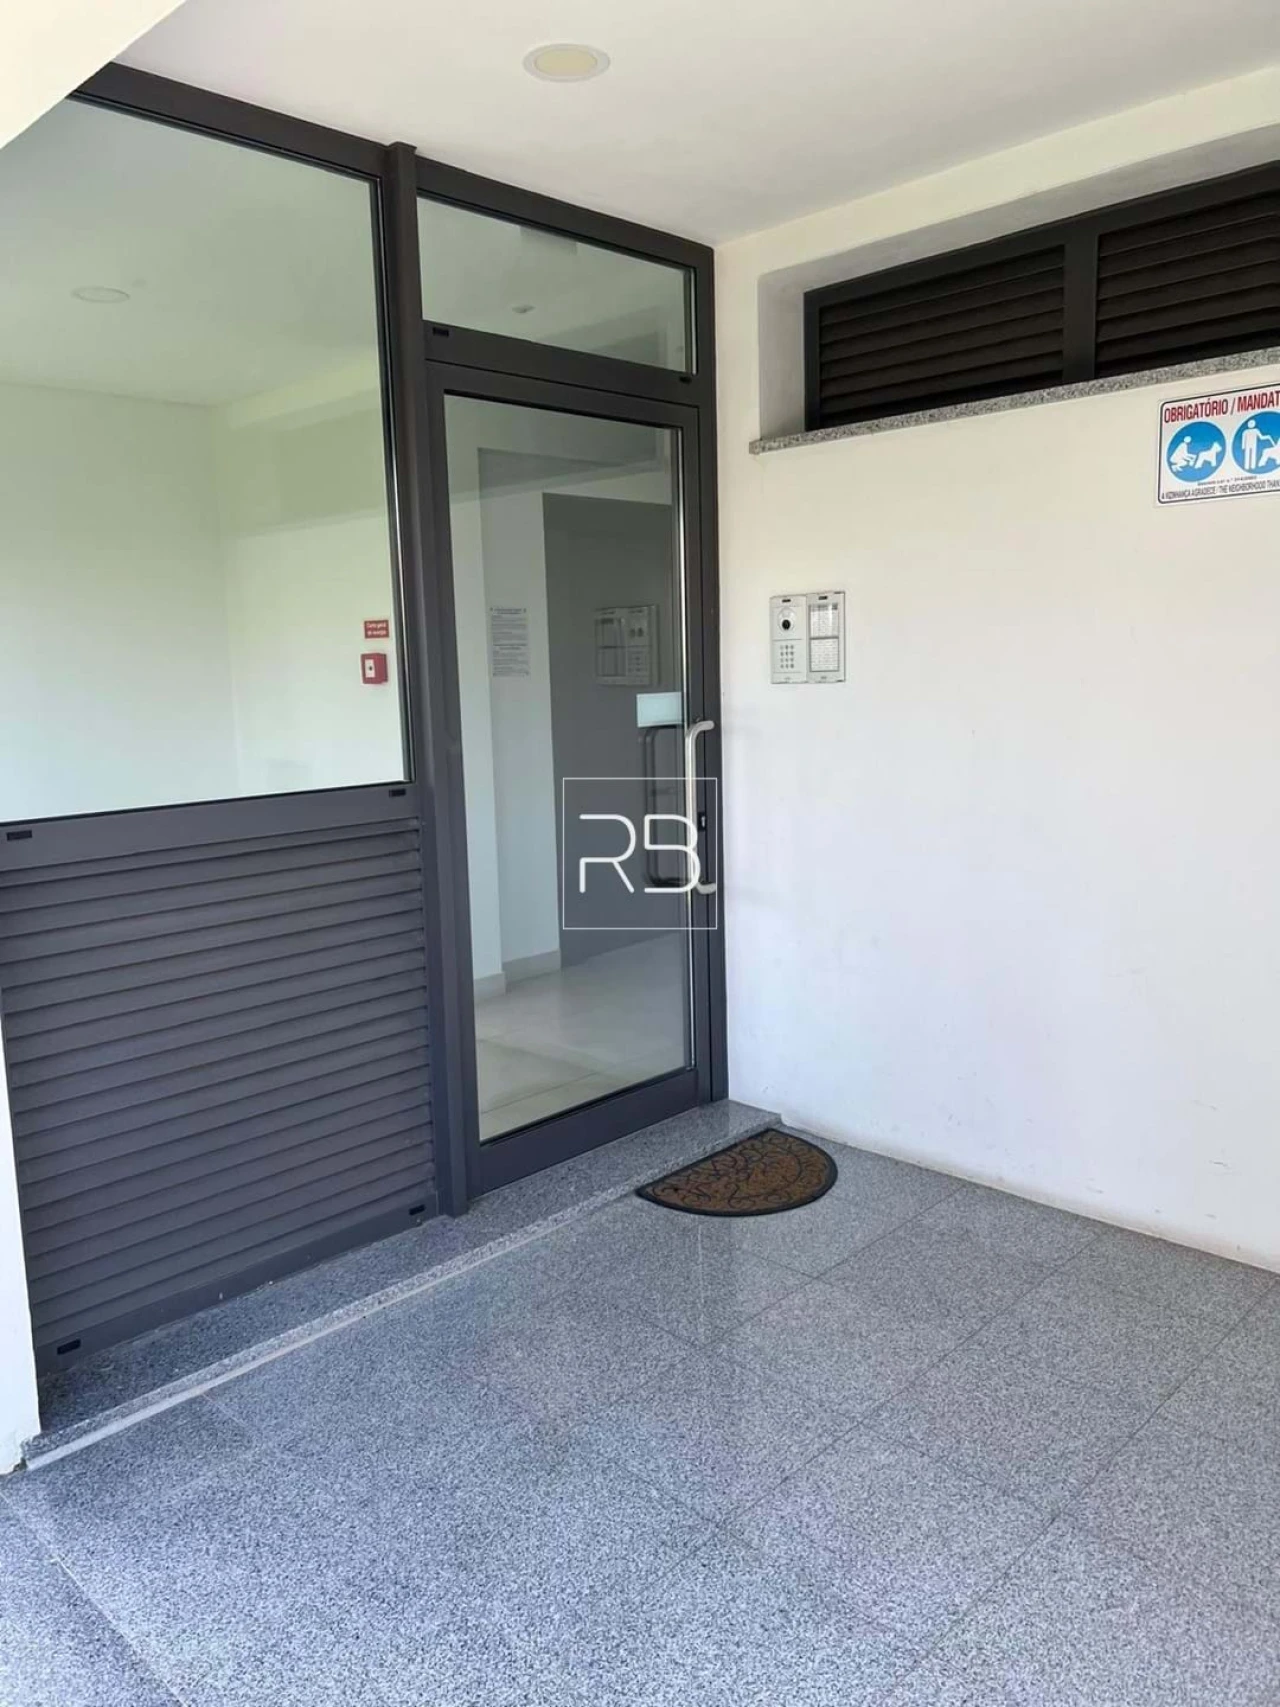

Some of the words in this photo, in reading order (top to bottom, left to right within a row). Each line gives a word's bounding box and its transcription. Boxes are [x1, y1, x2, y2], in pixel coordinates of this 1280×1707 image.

[1164, 398, 1229, 423] OBRIGATÓRIO
[1230, 398, 1236, 415] /
[1237, 390, 1280, 412] MANDAT
